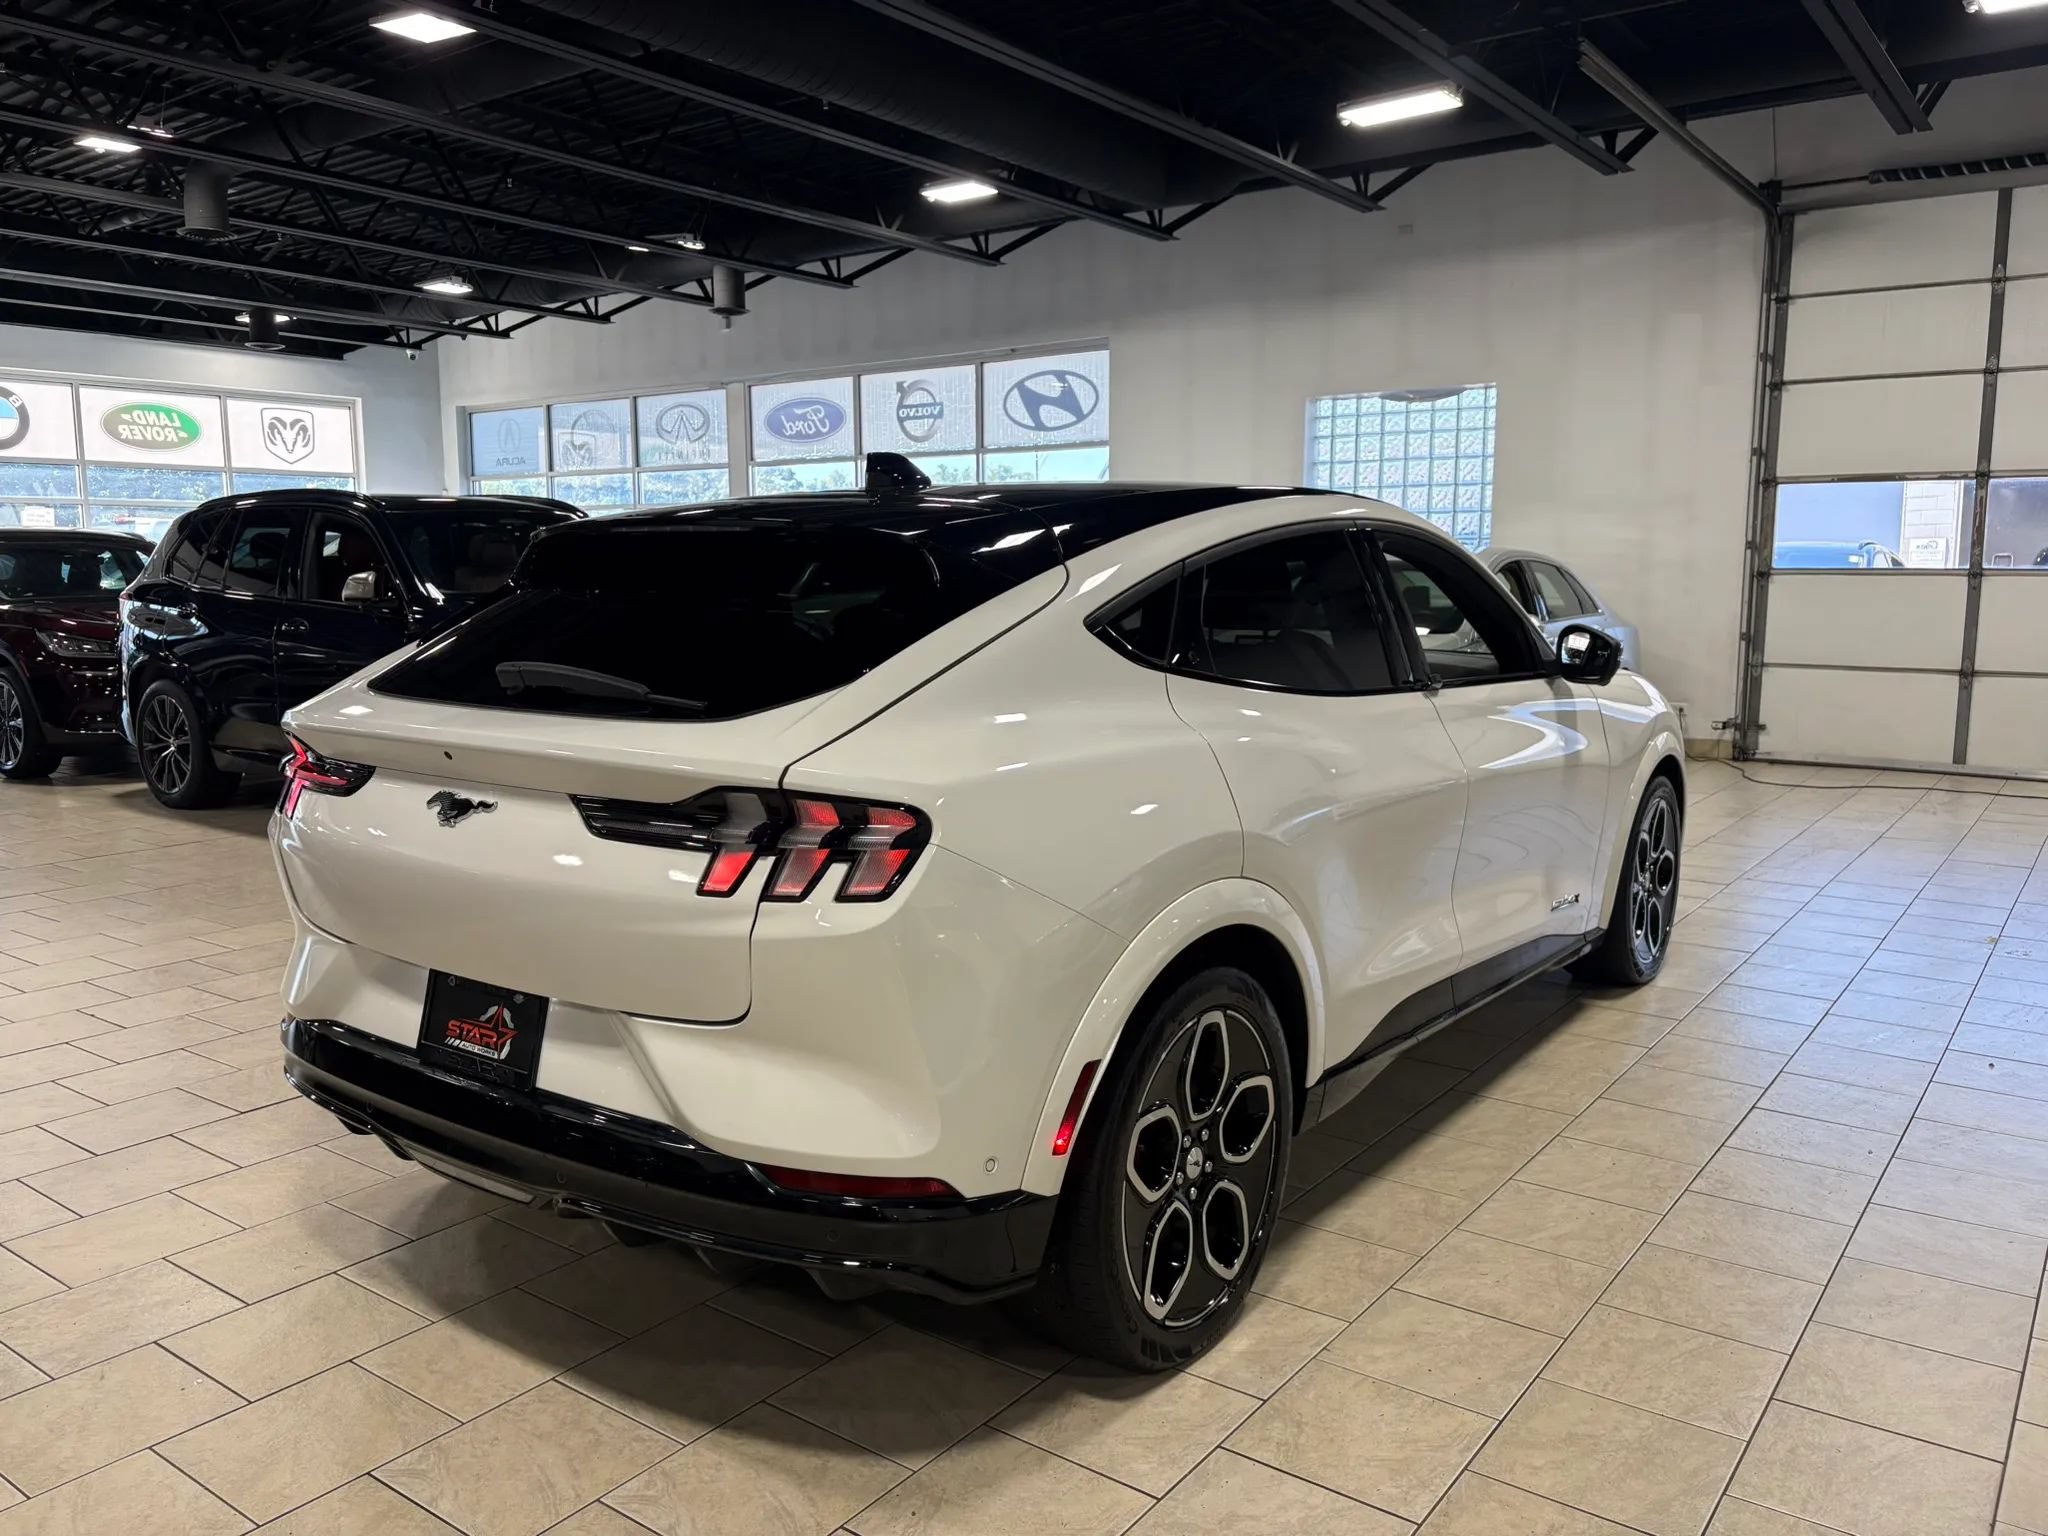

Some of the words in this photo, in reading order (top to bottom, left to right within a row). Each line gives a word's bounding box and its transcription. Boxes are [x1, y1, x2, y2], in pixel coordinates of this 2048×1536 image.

[447, 1020, 497, 1048] STAR
[462, 1042, 476, 1051] AUTO
[477, 1046, 496, 1056] WORKS
